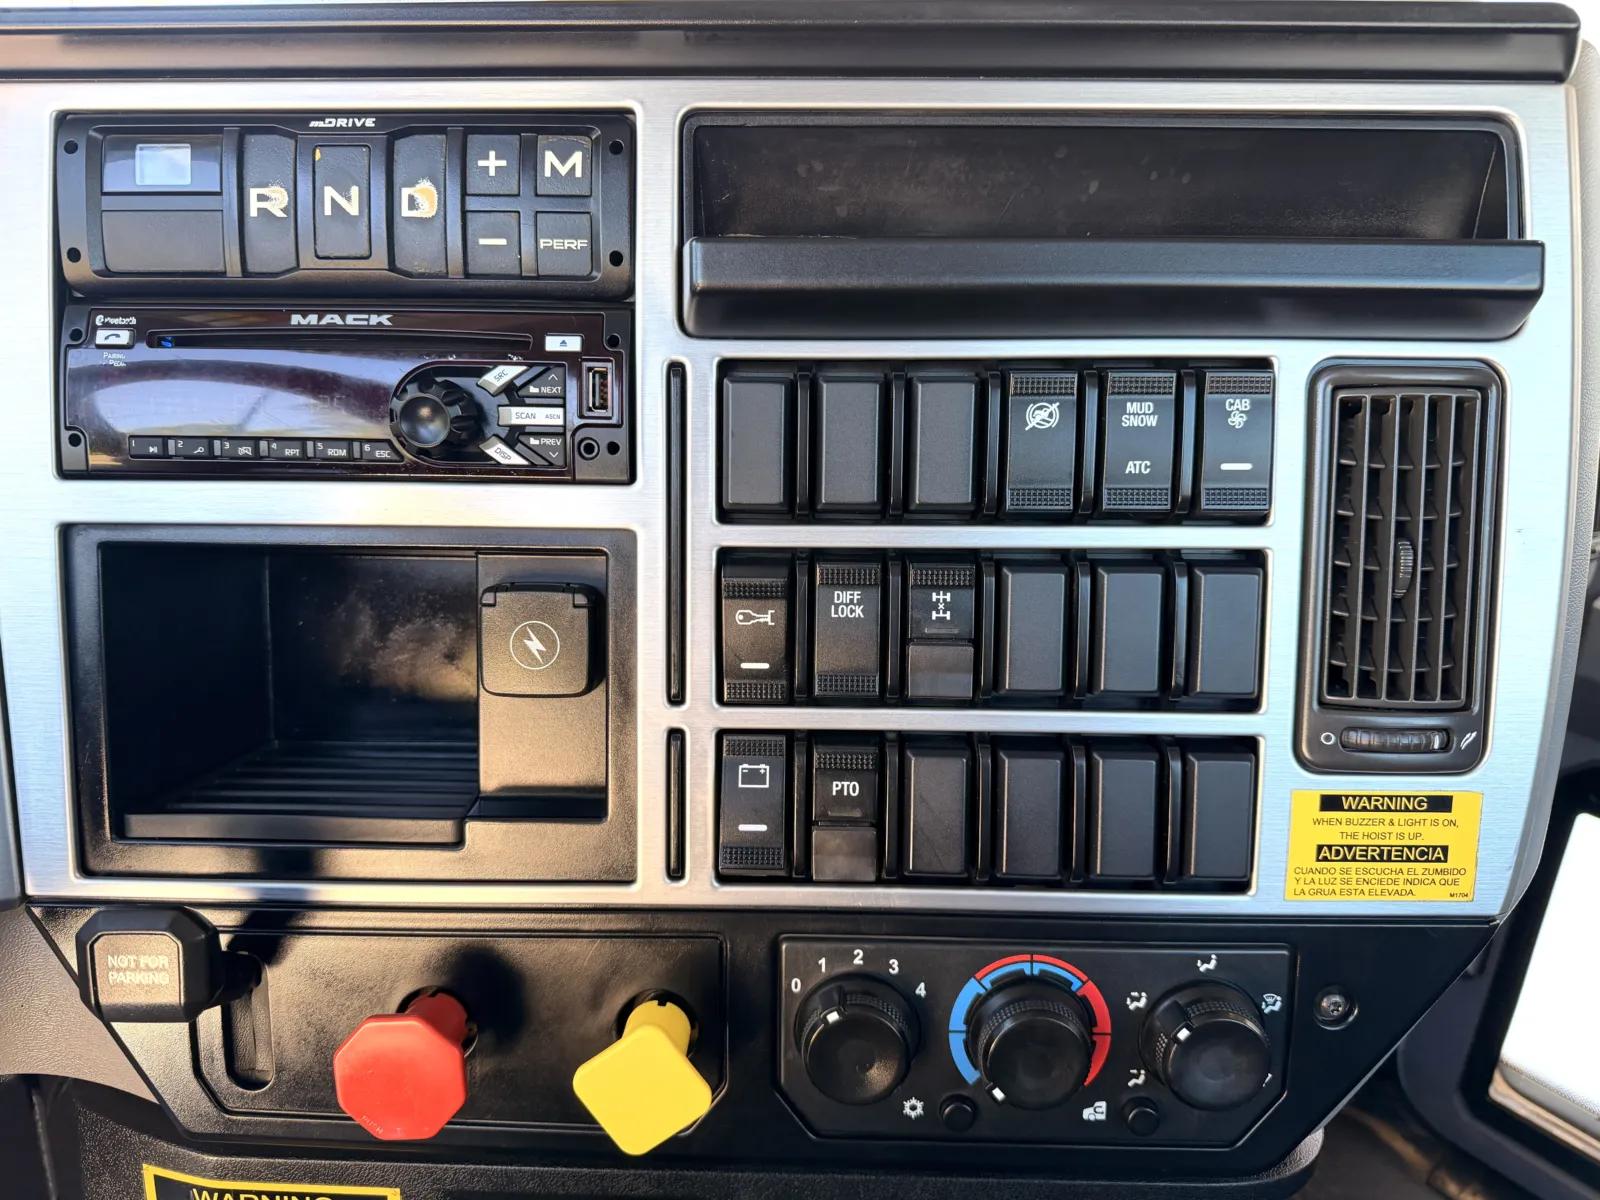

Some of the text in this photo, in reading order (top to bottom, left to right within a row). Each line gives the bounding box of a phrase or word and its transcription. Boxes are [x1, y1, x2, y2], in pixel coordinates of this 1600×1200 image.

[309, 117, 376, 128] mDRIVE
[544, 150, 583, 178] M
[249, 186, 289, 218] R
[323, 185, 360, 217] N
[401, 182, 438, 218] D
[540, 239, 588, 250] PERF
[290, 313, 394, 326] MACK
[494, 368, 509, 382] SRC
[540, 386, 562, 394] NEXT
[1126, 402, 1154, 414] MUD
[1225, 399, 1251, 411] CAB
[515, 411, 536, 420] SCAN
[1121, 414, 1159, 427] SNOW
[177, 440, 184, 448] 2
[271, 442, 277, 450] 4
[364, 444, 371, 452] 6
[540, 438, 562, 446] PREV
[285, 448, 300, 457] RPT
[375, 450, 391, 458] ESC
[494, 447, 512, 461] DISP
[1125, 461, 1151, 474] ATC
[834, 591, 862, 604] DIFF
[831, 605, 864, 618] LOCK
[832, 781, 860, 796] PTO
[1341, 796, 1428, 811] WARNING
[1312, 818, 1459, 828] WHEN BUZZER & LIGHT IS ON,
[1340, 832, 1425, 840] THE HOIST IS UP.
[1318, 846, 1445, 861] ADVERTENCIA
[1294, 867, 1467, 876] CUANDO SE ESCUCHA EL ZUMBIDO
[1295, 877, 1460, 886] Y LA LUZ SE ENCIEDE INDICA QUE
[1293, 888, 1416, 897] LA GRUA ESTA ELEVADA.
[107, 955, 169, 968] NOT FOR
[852, 949, 864, 965] 2
[817, 957, 826, 973] 1
[888, 958, 900, 975] 3
[108, 971, 170, 985] PARKING
[791, 977, 802, 993] 0
[915, 982, 927, 998] 4
